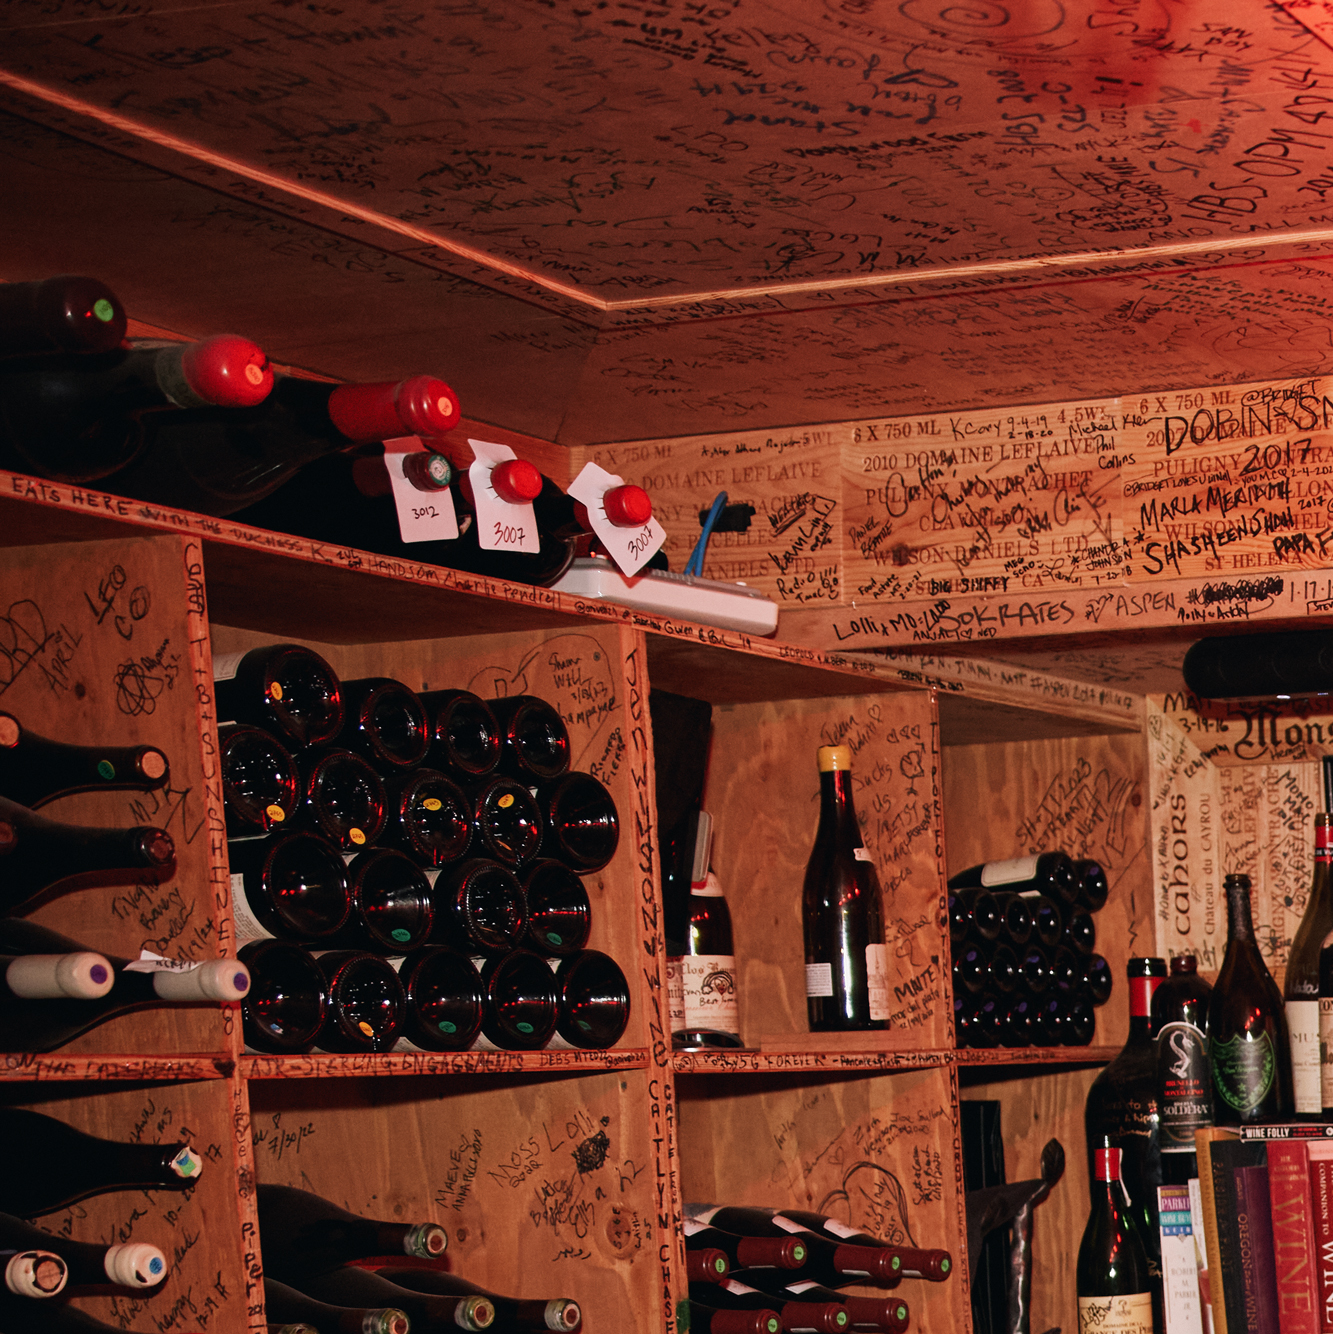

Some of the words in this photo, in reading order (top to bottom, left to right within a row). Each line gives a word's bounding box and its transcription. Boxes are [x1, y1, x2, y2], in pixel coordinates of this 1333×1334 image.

[1175, 391, 1204, 411] 750
[1211, 389, 1236, 406] ML
[884, 421, 912, 439] 750
[917, 420, 942, 437] ML
[863, 456, 898, 472] 2010
[1238, 438, 1314, 476] 2017
[730, 461, 822, 484] LEFLAIVE
[411, 504, 440, 521] 3012
[493, 520, 526, 548] 3007
[1115, 591, 1178, 617] ASPEN
[941, 600, 1076, 633] SOKRATES
[1246, 1128, 1266, 1139] WINE
[1267, 1127, 1289, 1138] FOLLY
[1318, 1163, 1329, 1219] COMPANION
[1275, 1193, 1312, 1315] WINE
